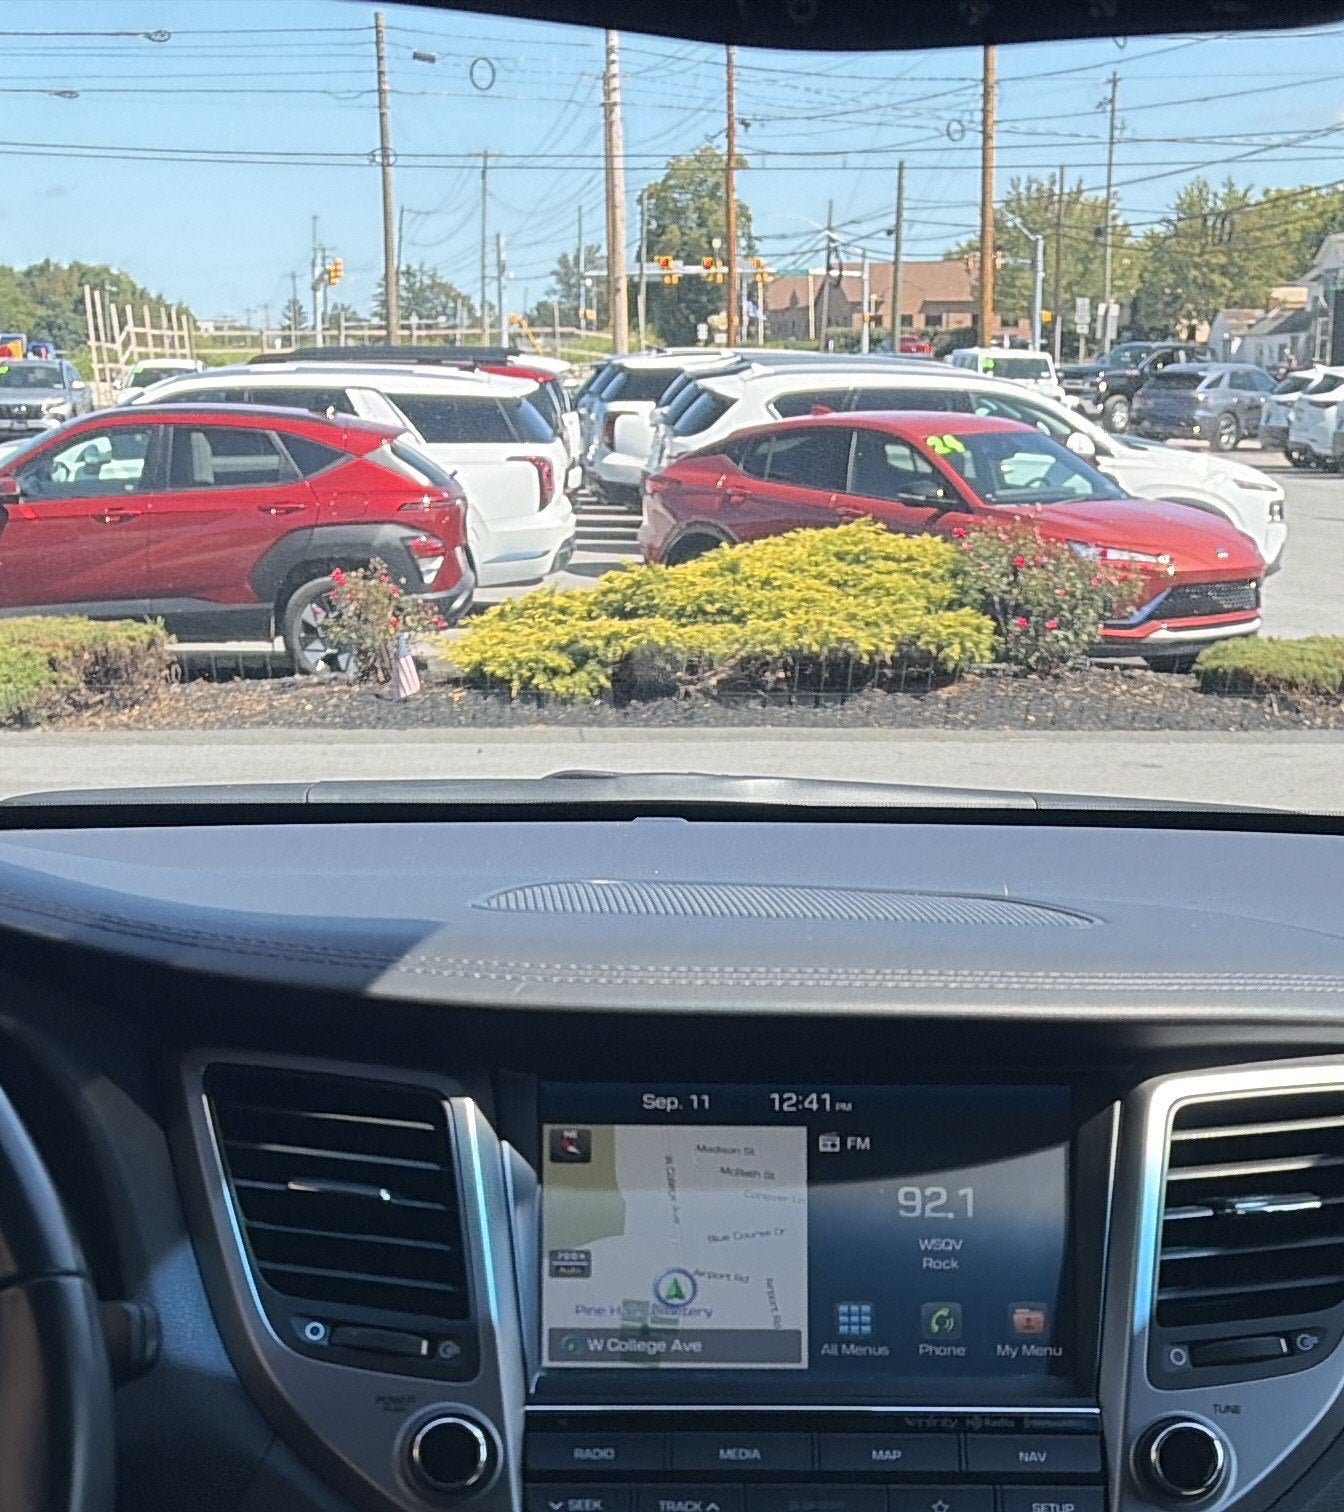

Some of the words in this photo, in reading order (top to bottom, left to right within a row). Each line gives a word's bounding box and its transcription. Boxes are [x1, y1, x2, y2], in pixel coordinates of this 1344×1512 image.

[926, 434, 965, 455] 24
[642, 1093, 684, 1112] Sep.
[688, 1094, 710, 1109] 11
[769, 1093, 831, 1112] 12:41
[846, 1136, 871, 1150] FM
[896, 1185, 975, 1219] 92.1
[922, 1257, 960, 1270] Rock
[586, 1338, 604, 1352] W
[606, 1338, 667, 1355] College
[671, 1338, 703, 1353] Ave
[820, 1343, 839, 1356] All
[841, 1343, 890, 1356] Menus
[918, 1343, 967, 1357] Phone
[996, 1344, 1017, 1359] My
[1019, 1344, 1063, 1357] Menu
[572, 1447, 616, 1461] RADIO
[718, 1446, 762, 1461] MEDIA
[870, 1448, 902, 1462] MAP
[1018, 1450, 1048, 1464] NAV
[566, 1497, 604, 1512] SEEK
[658, 1498, 703, 1512] TRACK
